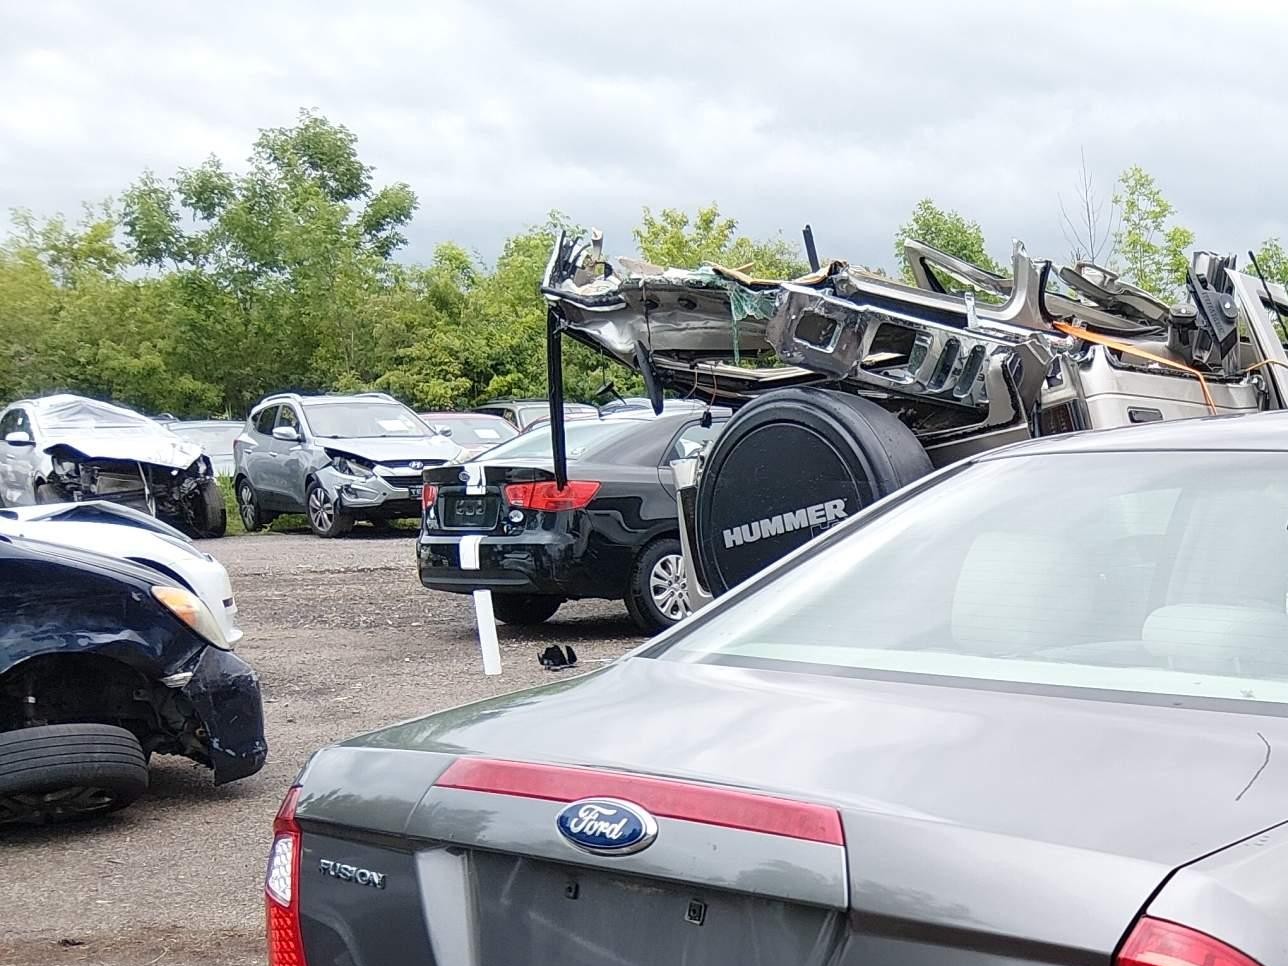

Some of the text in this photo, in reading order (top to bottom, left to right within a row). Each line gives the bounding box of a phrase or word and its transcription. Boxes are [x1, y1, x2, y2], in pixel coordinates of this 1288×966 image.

[723, 498, 848, 549] HUMMER
[569, 804, 628, 840] Ford
[319, 858, 385, 889] FUSION
